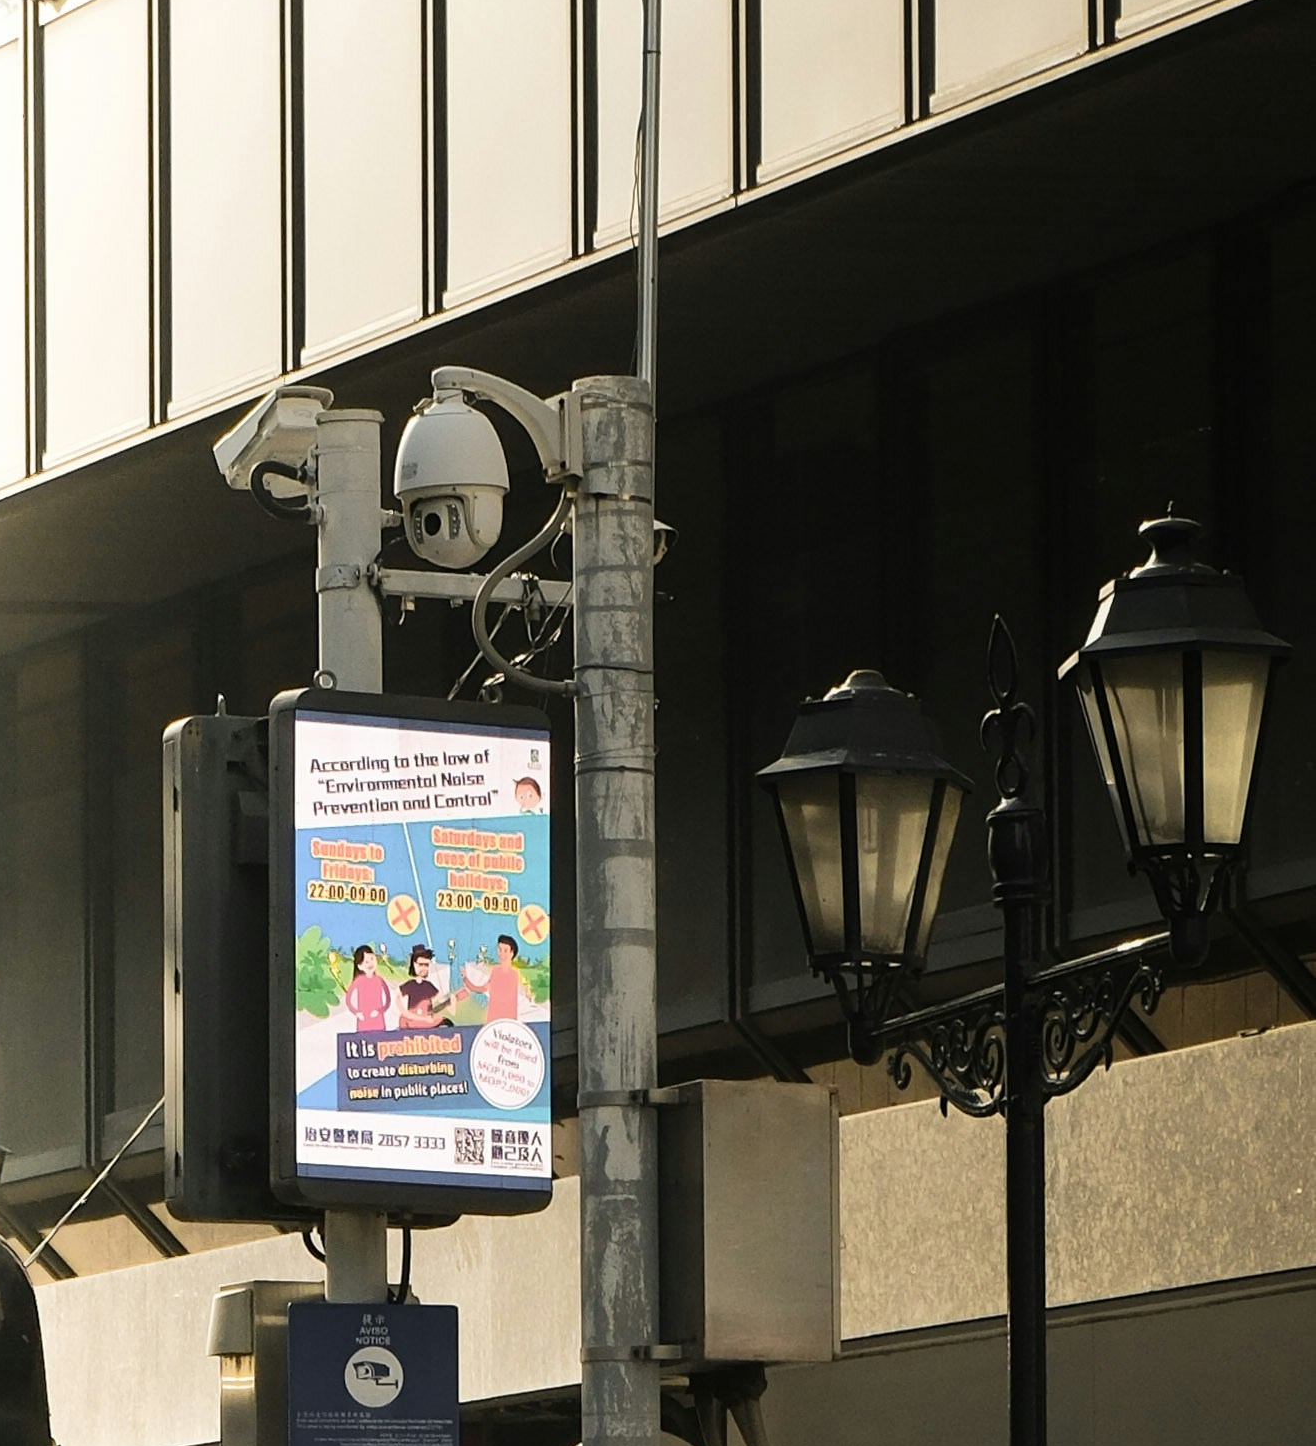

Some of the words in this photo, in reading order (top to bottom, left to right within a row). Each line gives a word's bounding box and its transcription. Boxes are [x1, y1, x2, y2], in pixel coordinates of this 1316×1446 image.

[310, 755, 390, 774] According
[395, 755, 410, 769] to
[414, 752, 439, 767] the
[474, 748, 491, 764] of
[441, 772, 485, 788] Noise
[313, 796, 400, 816] Prevention
[403, 795, 431, 810] and
[433, 828, 496, 850] Saturdays
[499, 833, 524, 851] and
[312, 840, 366, 860] Sundays
[369, 844, 384, 860] to
[435, 852, 465, 868] eves
[468, 853, 481, 869] of
[483, 853, 524, 872] public
[438, 892, 473, 910] 23:00
[483, 895, 519, 914] 09:00
[346, 1041, 359, 1058] It
[361, 1041, 376, 1057] is
[378, 1034, 462, 1061] prohibited
[347, 1067, 361, 1079] to
[361, 1064, 396, 1079] create
[398, 1061, 456, 1077] disturbing
[349, 1087, 379, 1100] noise
[381, 1086, 392, 1099] in
[394, 1082, 428, 1100] public
[430, 1080, 469, 1098] places!
[377, 1133, 410, 1148] 2857
[413, 1135, 446, 1150] 3333
[355, 1336, 391, 1346] NOTICE
[359, 1326, 389, 1336] AVISO
